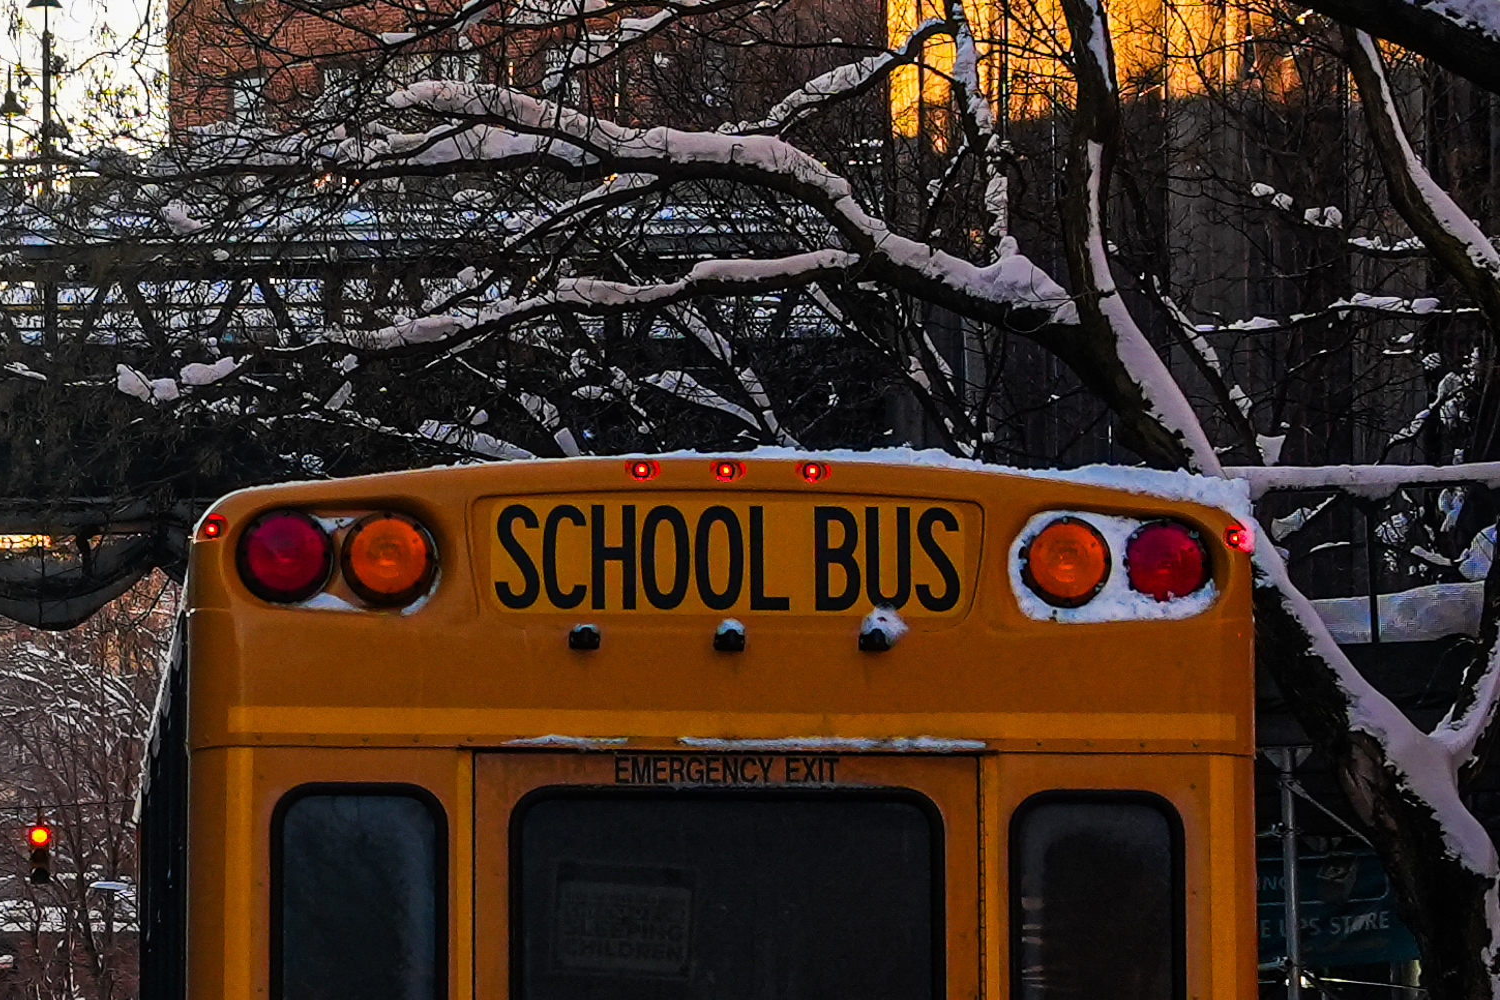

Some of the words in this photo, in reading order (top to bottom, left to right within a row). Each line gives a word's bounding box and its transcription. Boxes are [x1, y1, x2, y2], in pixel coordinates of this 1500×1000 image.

[494, 504, 790, 612] SCHOOL
[814, 506, 962, 612] BUS
[614, 756, 773, 785] EMERGENCY
[784, 756, 839, 784] EXIT
